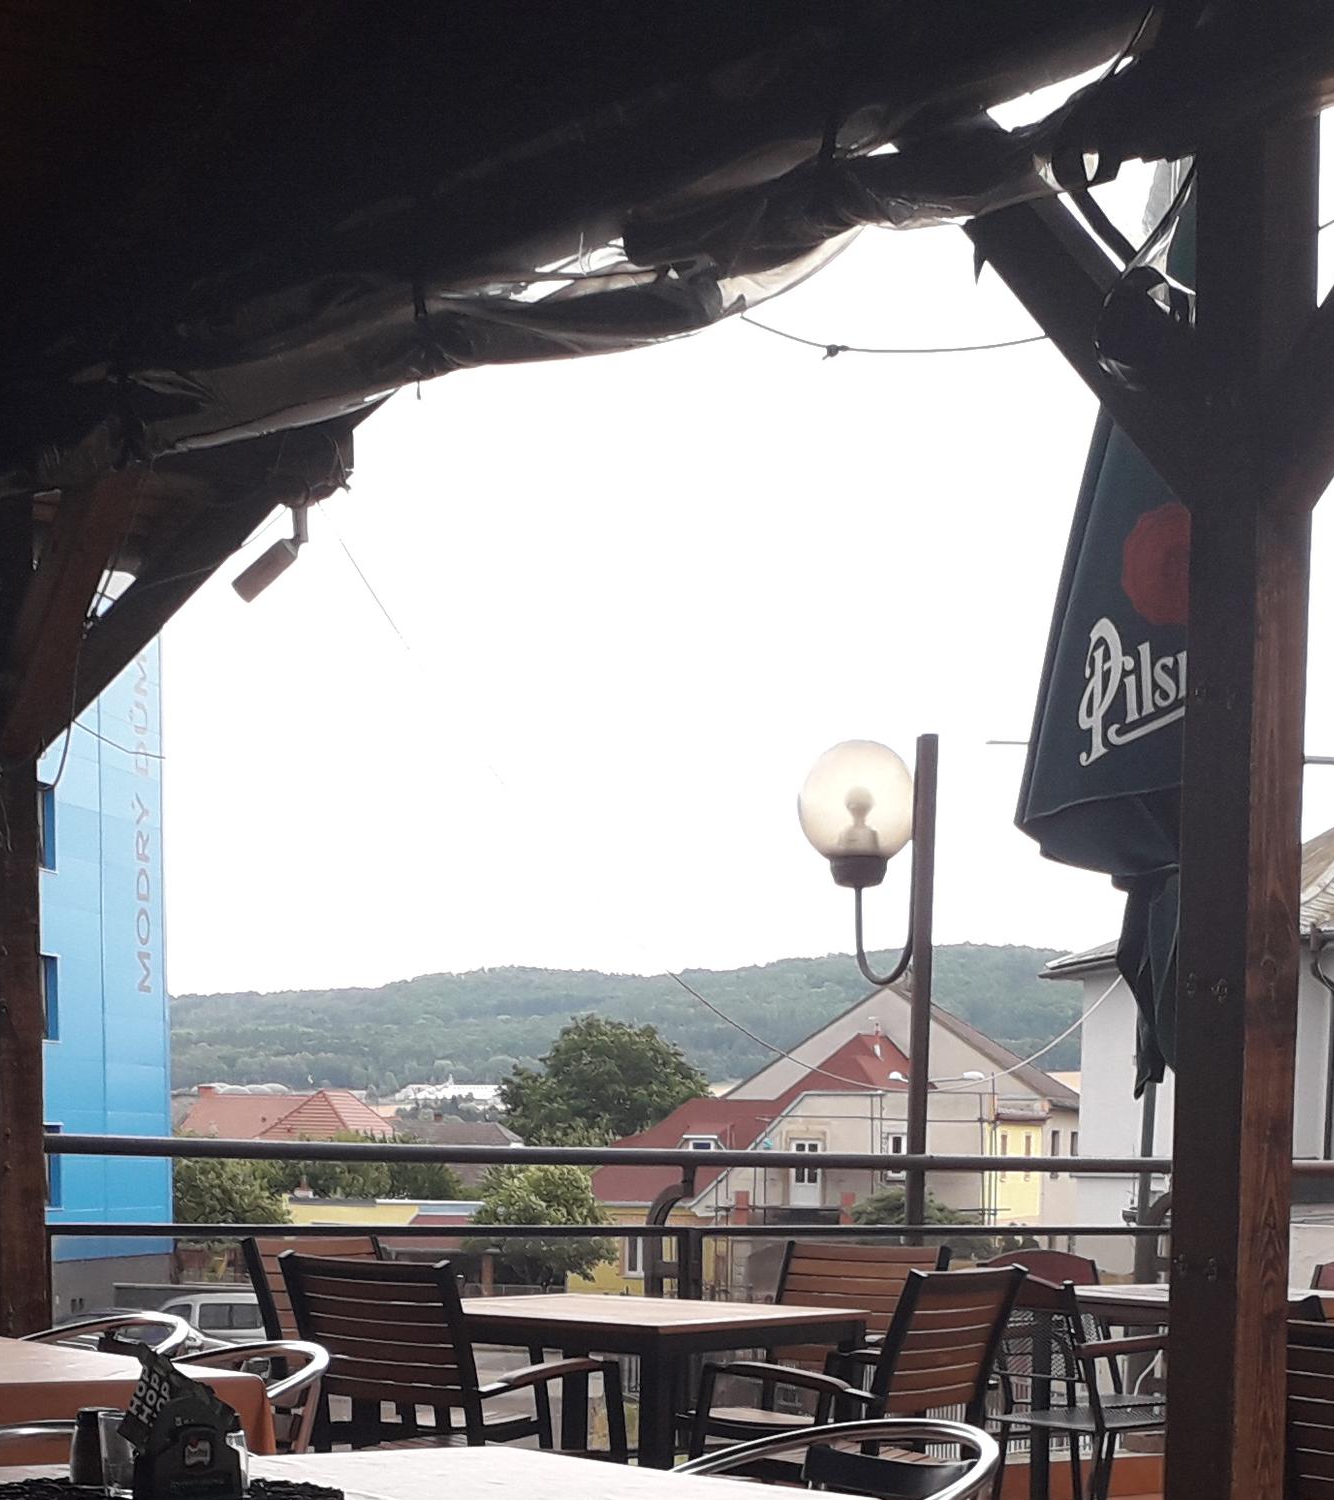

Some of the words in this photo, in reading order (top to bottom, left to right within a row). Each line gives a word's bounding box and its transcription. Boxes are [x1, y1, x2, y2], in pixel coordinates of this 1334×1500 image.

[126, 653, 149, 776] DŮM
[130, 792, 153, 993] MODRÝ
[137, 1373, 160, 1424] HOP
